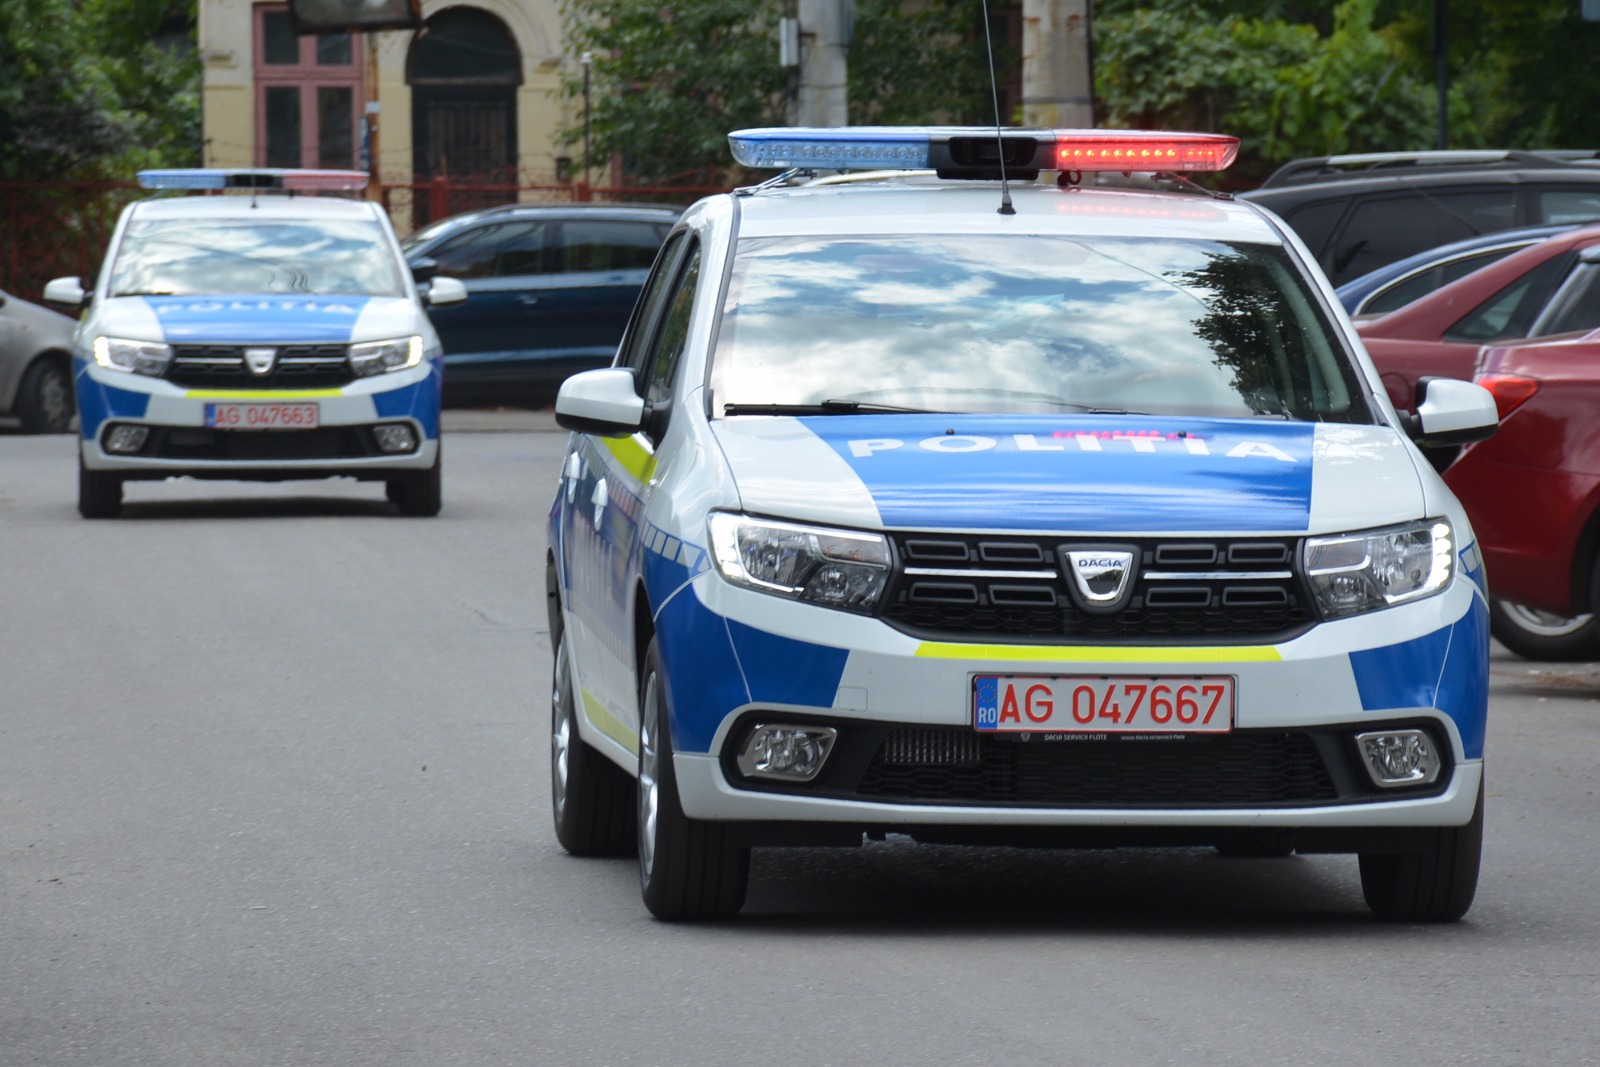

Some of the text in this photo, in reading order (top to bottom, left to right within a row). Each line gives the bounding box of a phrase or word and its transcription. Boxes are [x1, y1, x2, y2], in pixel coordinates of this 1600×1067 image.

[216, 407, 315, 424] AG 047663
[1078, 559, 1122, 567] DACIA
[978, 683, 1225, 724] RO AG 047667
